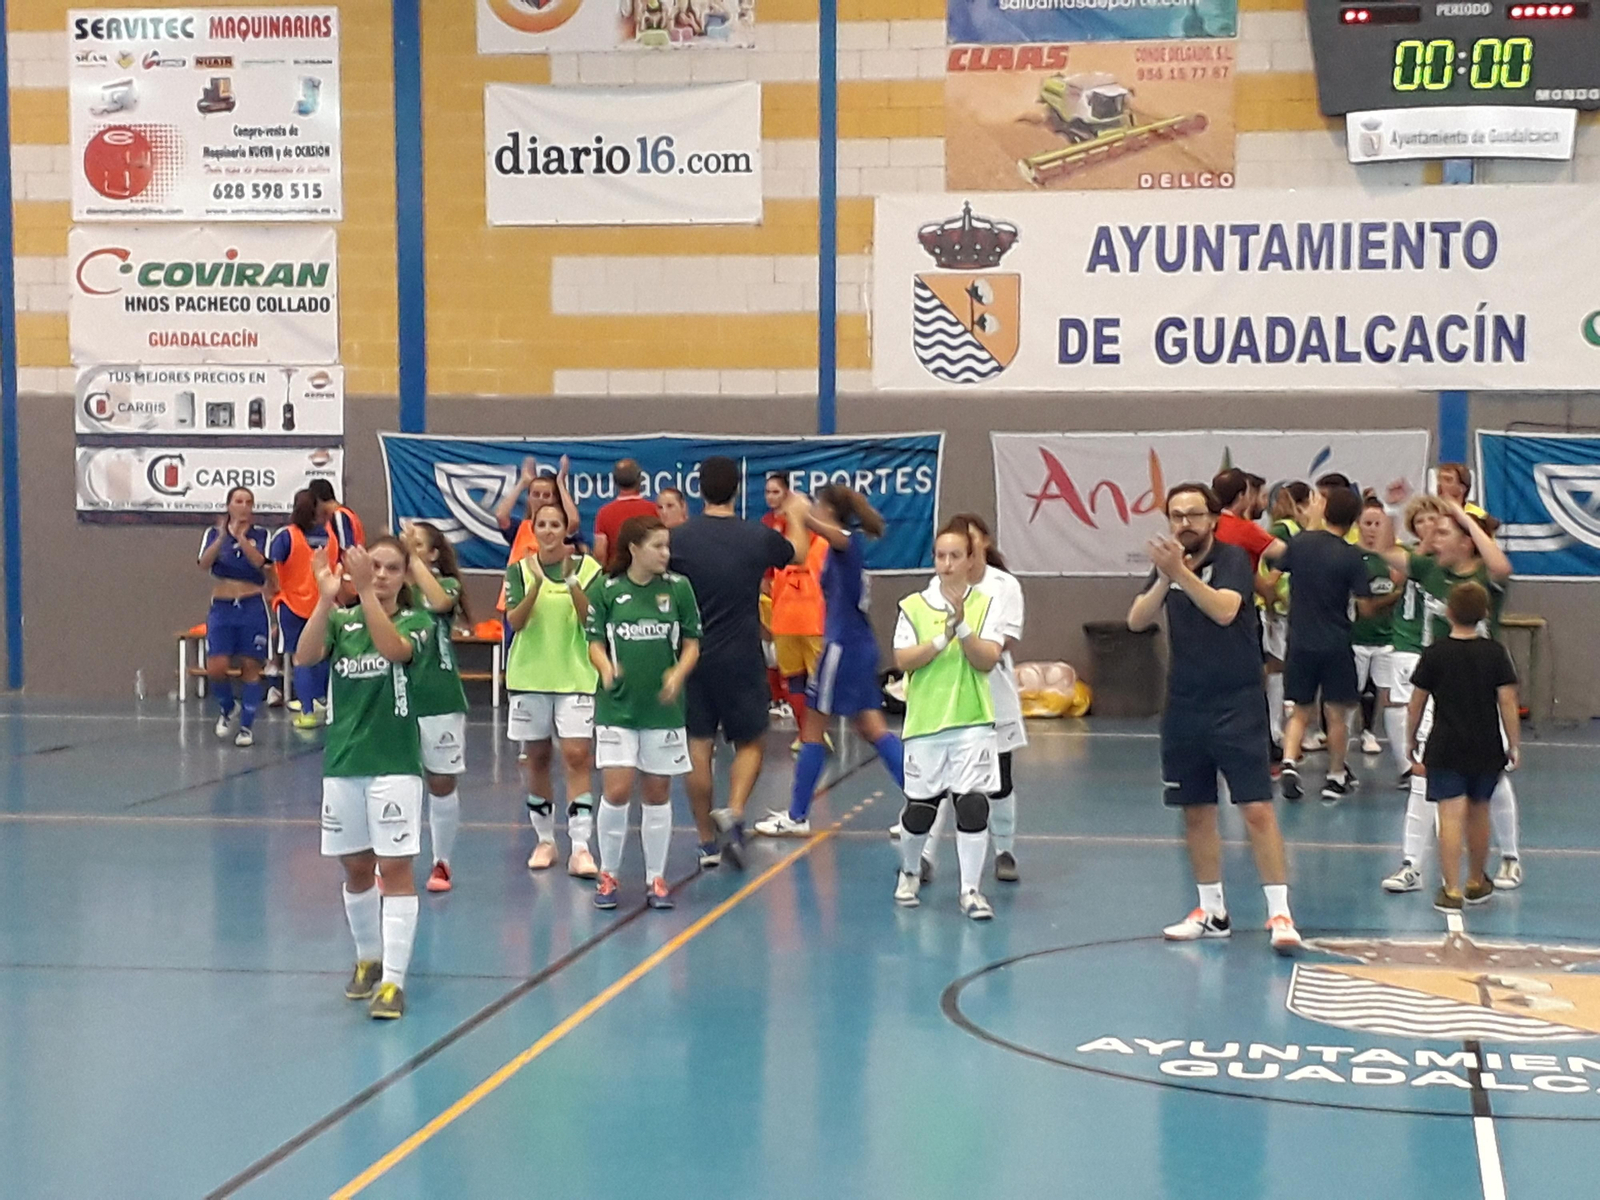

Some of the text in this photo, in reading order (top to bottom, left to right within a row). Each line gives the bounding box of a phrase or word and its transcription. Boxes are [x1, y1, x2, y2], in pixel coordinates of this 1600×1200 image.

[1436, 4, 1492, 16] PERIODO
[75, 15, 332, 41] SERVITEC MAQUINARIAS
[949, 46, 1068, 71] CLAAS
[1393, 38, 1532, 90] 00:00
[1192, 67, 1206, 79] 77
[1535, 89, 1600, 101] MONDO
[1390, 130, 1468, 150] Ayuntamiento
[1470, 132, 1485, 144] de
[1138, 173, 1235, 189] DELCO
[213, 183, 322, 199] 628 598 515
[1087, 220, 1497, 273] AYUNTAMIENTO
[125, 297, 330, 312] HNOS PACHECO COLLADO
[149, 329, 258, 347] GUADALCACÍN
[1058, 317, 1121, 364] DE
[1155, 303, 1526, 364] GUADALCACÍN
[108, 371, 265, 383] TUS MEJORES PRECIOS EN
[195, 470, 275, 487] CARBIS
[766, 465, 932, 497] EPORTES
[1160, 1059, 1600, 1093] GUADALC
